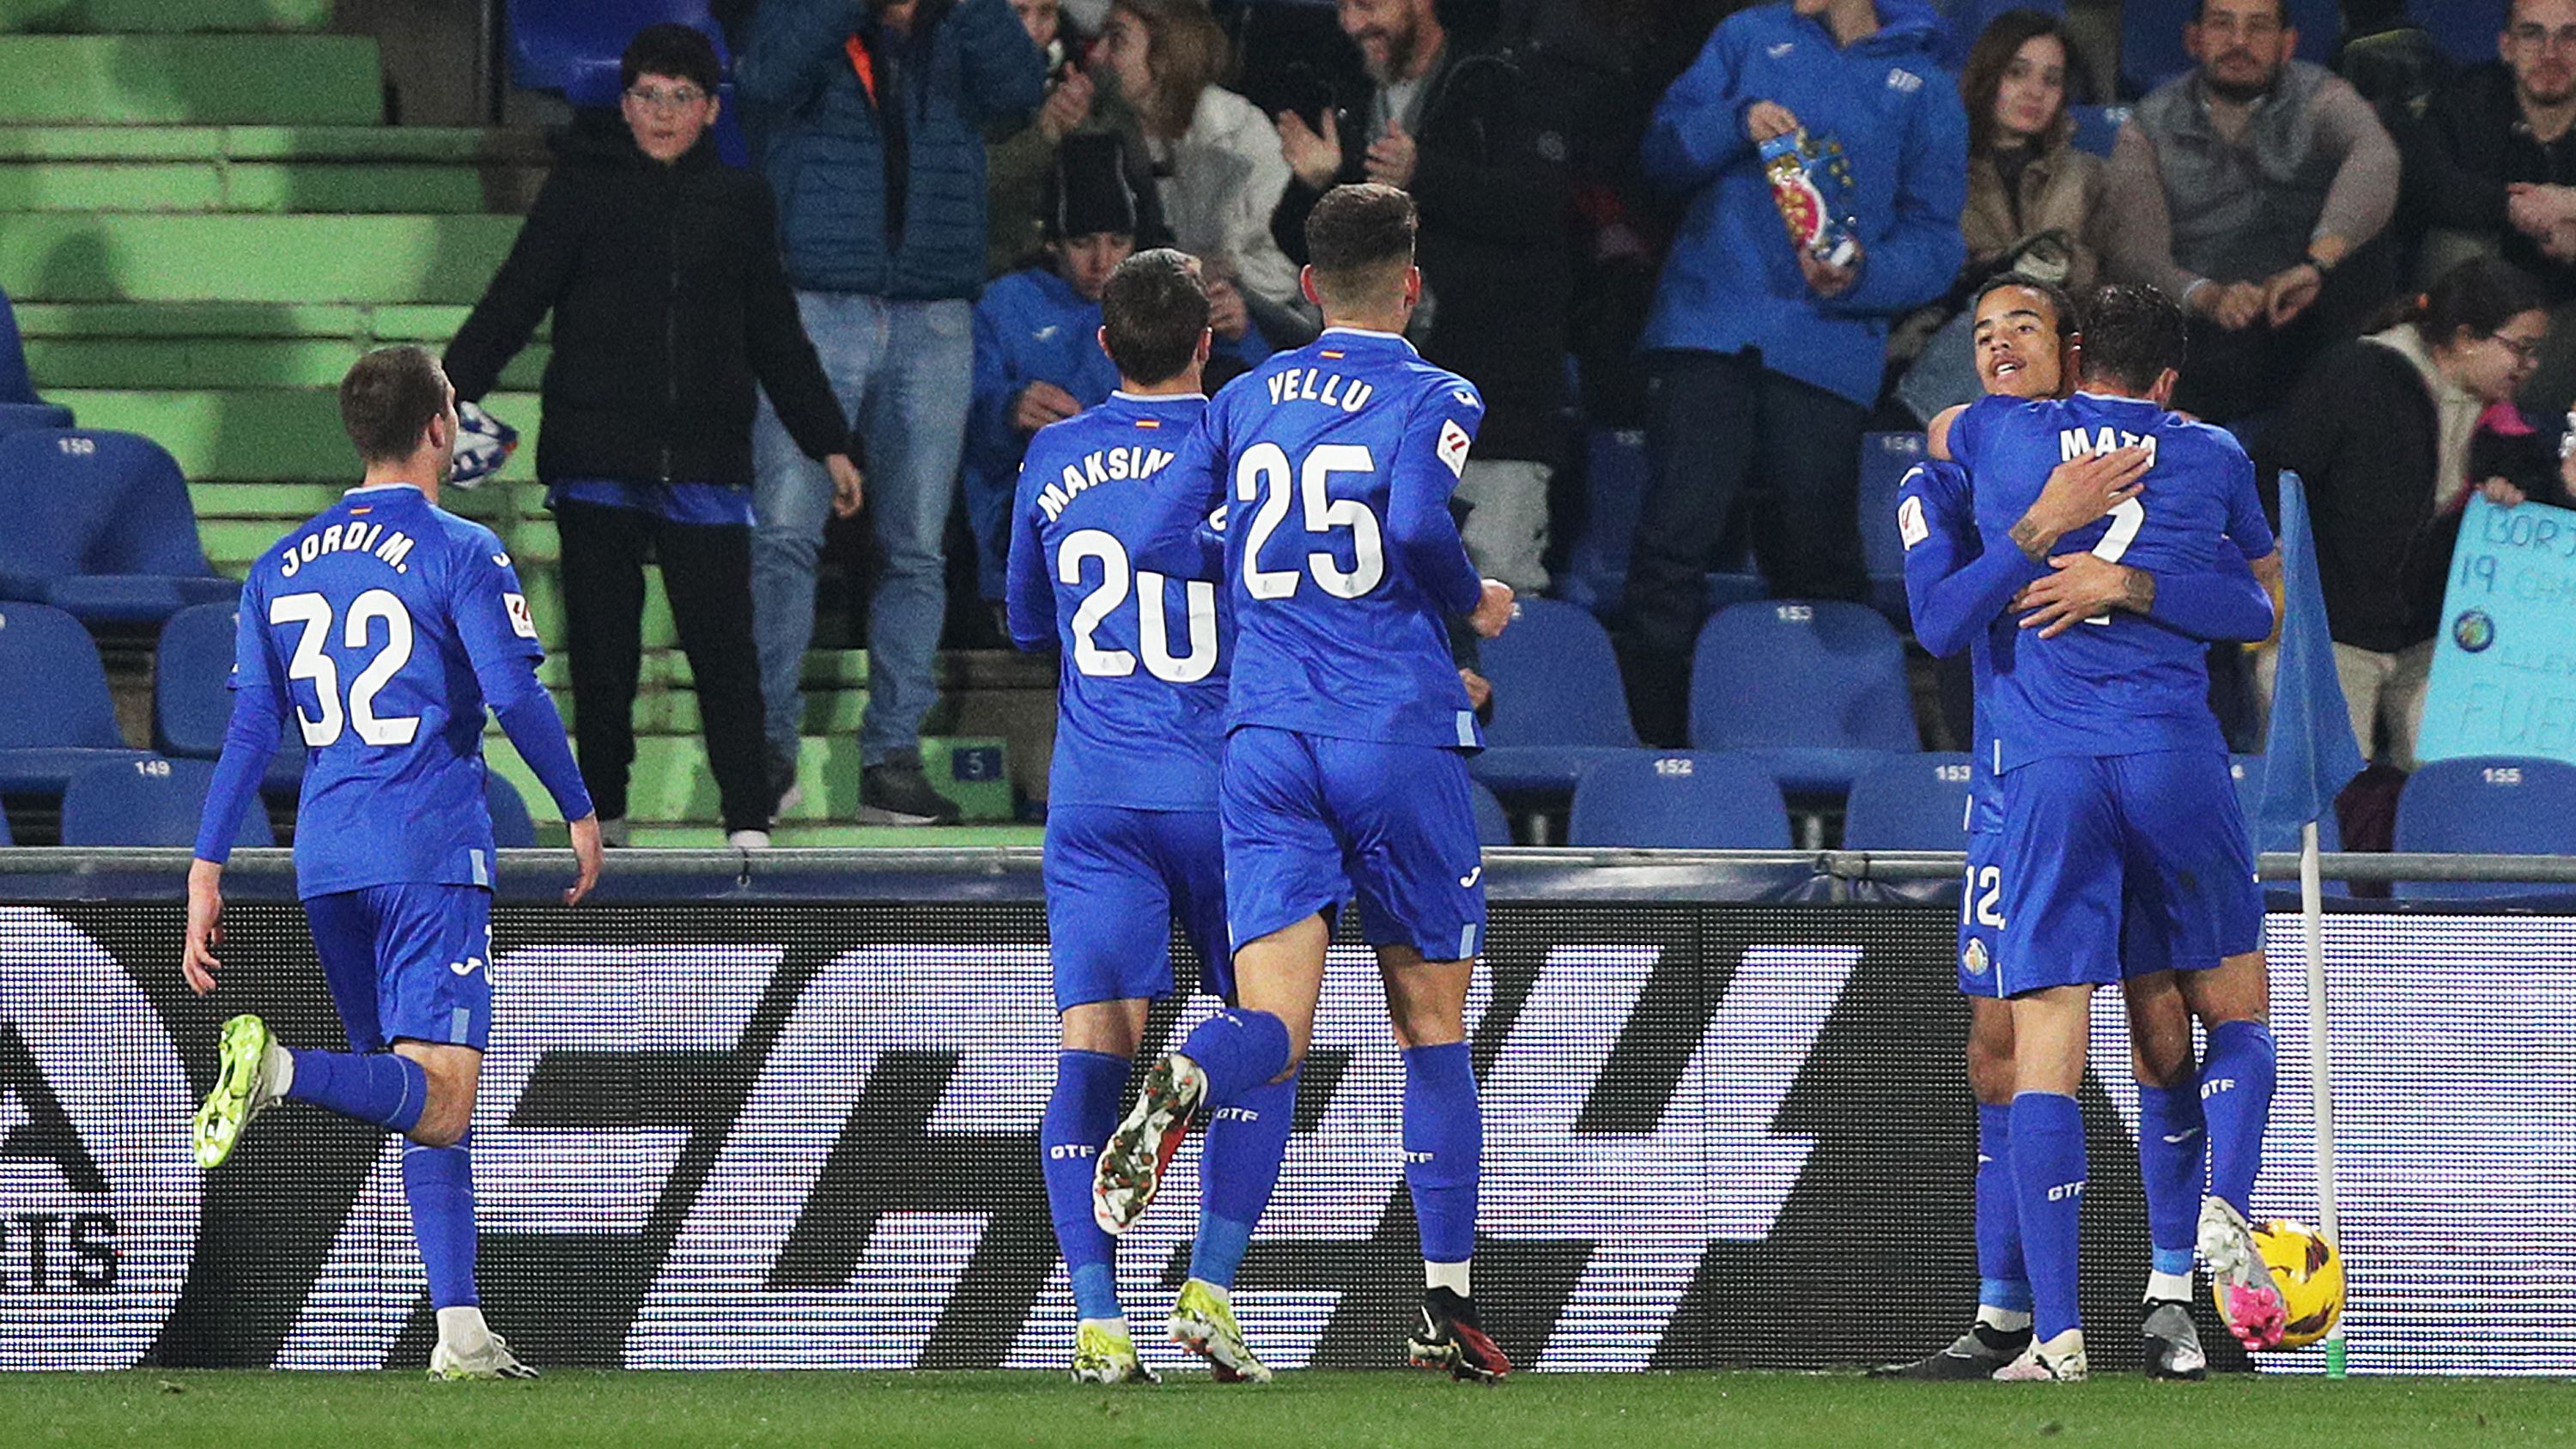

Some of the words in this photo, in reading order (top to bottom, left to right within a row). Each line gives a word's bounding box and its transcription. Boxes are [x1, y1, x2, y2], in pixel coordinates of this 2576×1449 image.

[1267, 368, 1373, 413] YELLU
[58, 438, 95, 454] 150
[1236, 442, 1384, 599] 25
[2484, 505, 2576, 558] BORJ
[281, 521, 383, 578] JORDI
[374, 530, 415, 574] M.
[2460, 555, 2496, 593] 19
[1058, 529, 1218, 682] 20
[1777, 605, 1812, 620] 153
[270, 589, 420, 746] 32
[135, 760, 171, 776] 149
[969, 751, 984, 774] 5
[1654, 759, 1692, 774] 152
[1935, 765, 1971, 781] 153
[2483, 767, 2521, 783] 155
[1963, 865, 2005, 931] 12
[2200, 1079, 2236, 1100] GTF
[1217, 1107, 1259, 1122] GTF
[1051, 1144, 1096, 1160] GTF
[1401, 1151, 1434, 1164] TF
[2048, 1180, 2085, 1202] GTF
